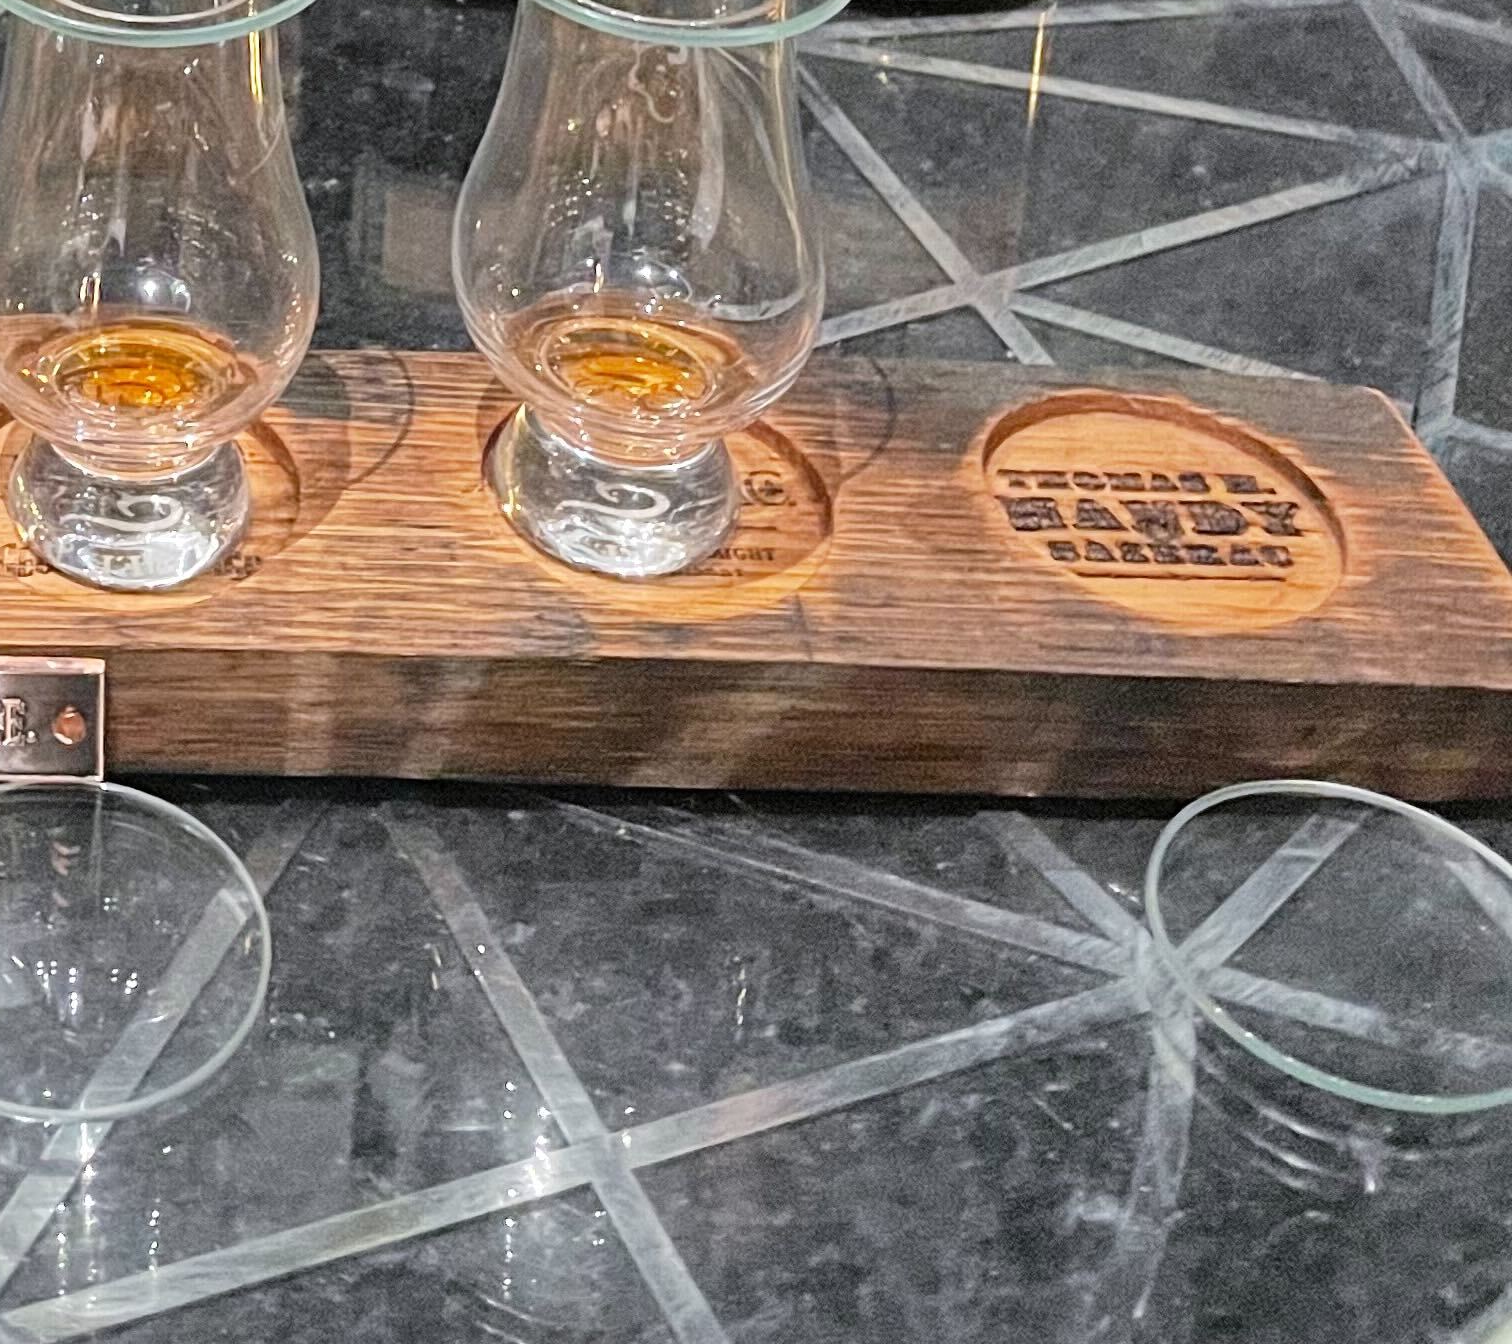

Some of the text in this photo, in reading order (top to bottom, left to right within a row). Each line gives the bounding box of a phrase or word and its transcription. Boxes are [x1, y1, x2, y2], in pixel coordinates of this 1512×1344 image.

[997, 468, 1211, 495] THOMAS
[994, 495, 1305, 538] HANDY
[1048, 539, 1295, 567] SAZERAC
